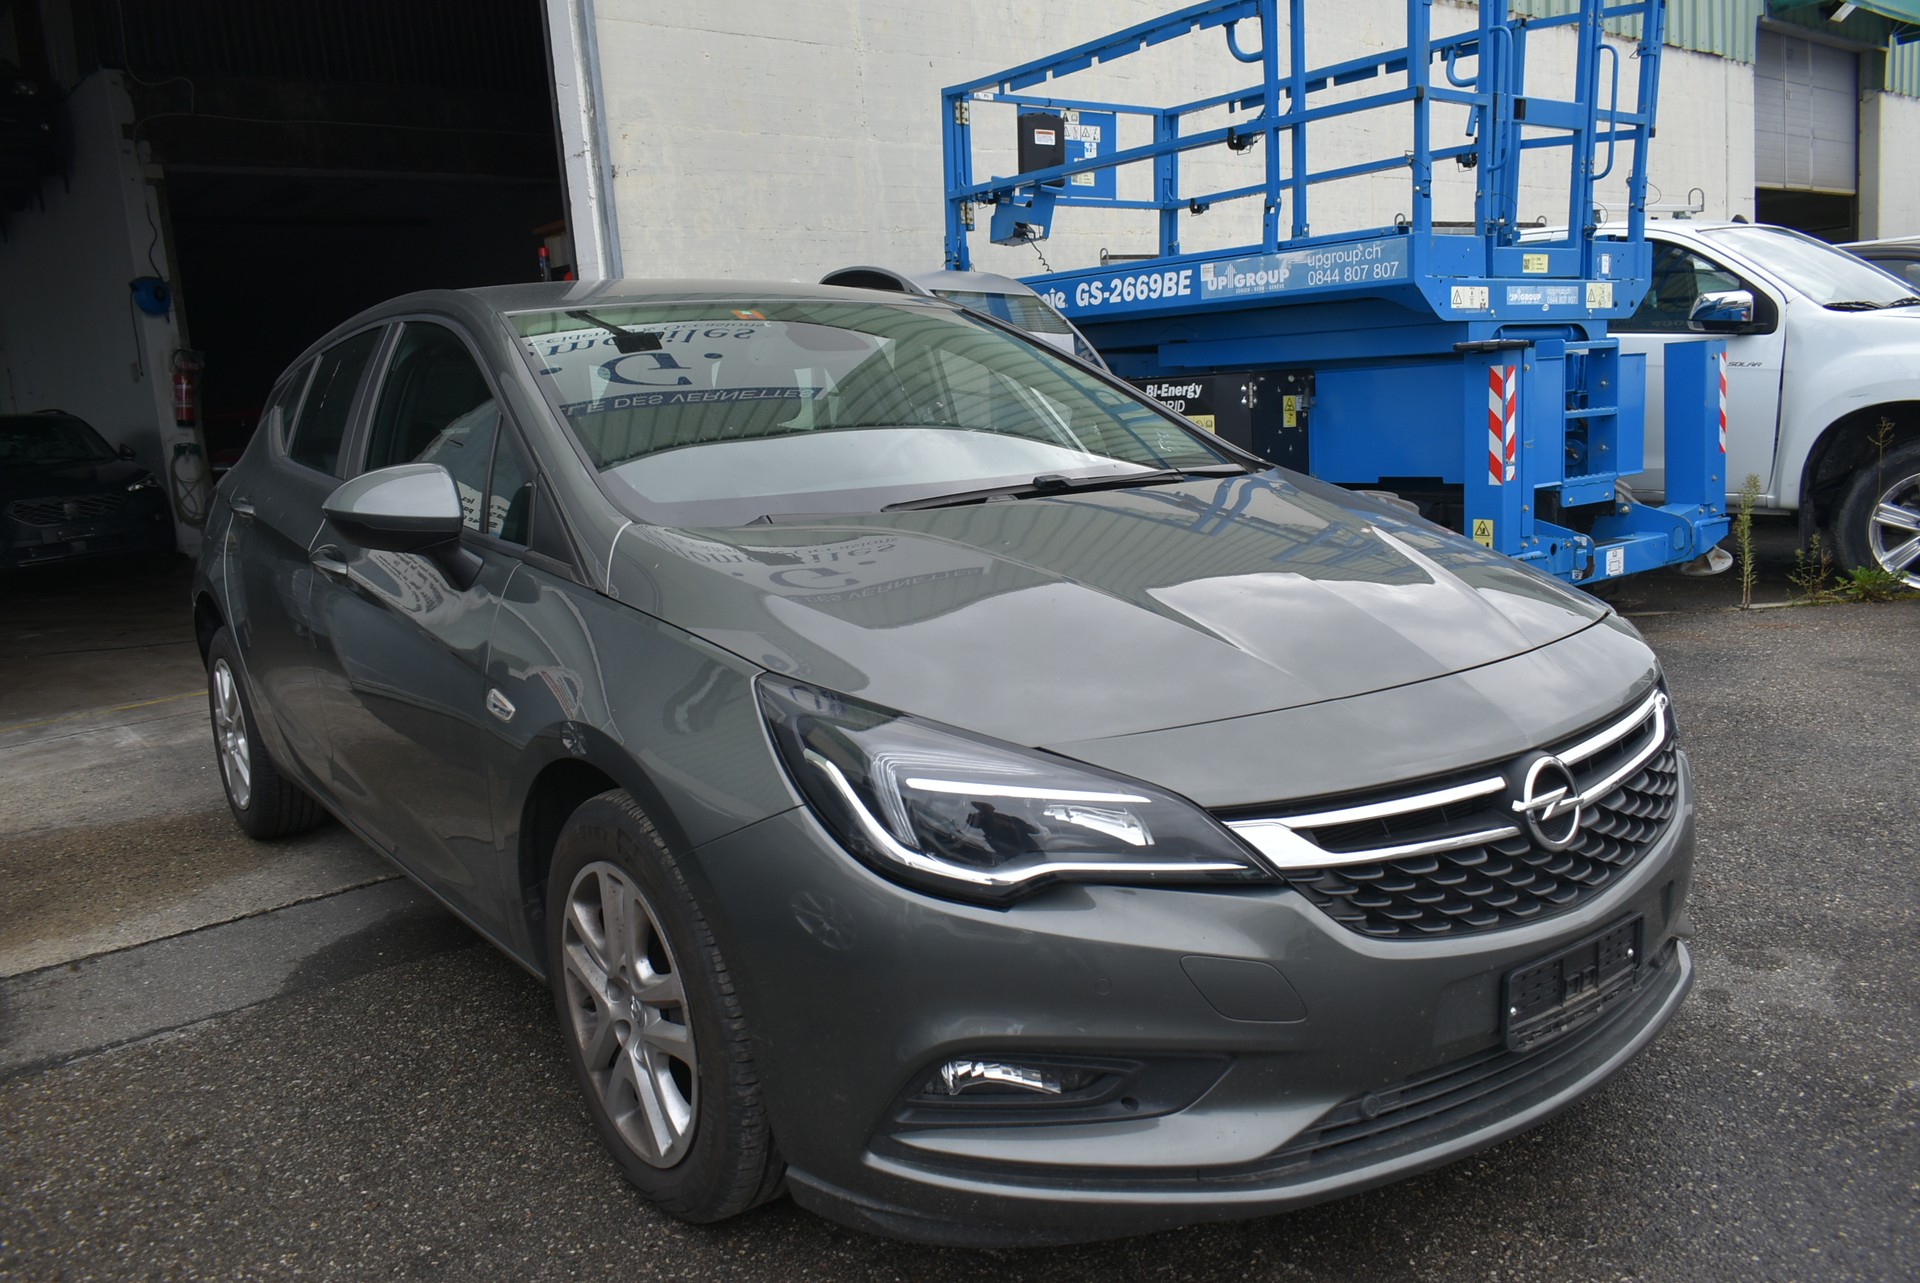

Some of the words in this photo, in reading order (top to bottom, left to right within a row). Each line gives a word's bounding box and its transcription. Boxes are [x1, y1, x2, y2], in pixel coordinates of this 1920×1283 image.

[1307, 243, 1381, 269] upgroup.ch
[1308, 268, 1339, 285] 0844
[1344, 265, 1368, 282] 807
[1373, 261, 1399, 278] 807
[1075, 269, 1193, 307] GS-2669BE
[1146, 383, 1202, 399] Bi-Energy
